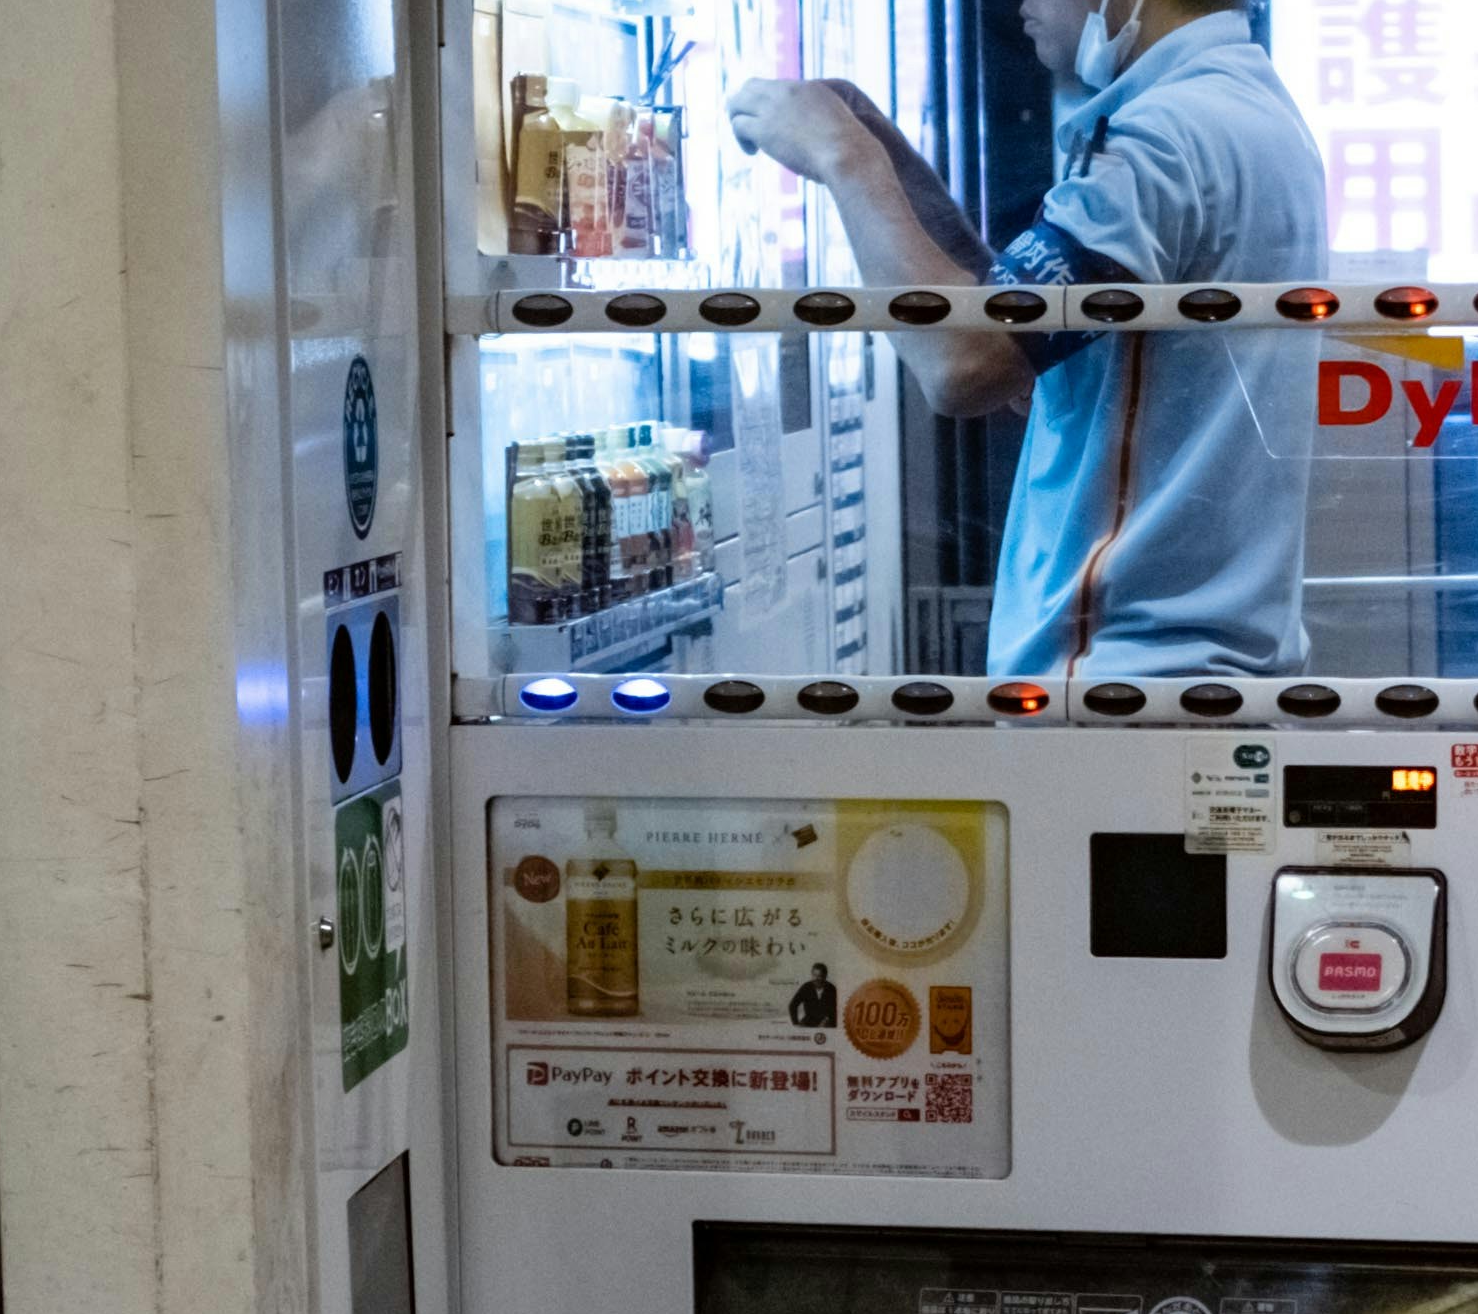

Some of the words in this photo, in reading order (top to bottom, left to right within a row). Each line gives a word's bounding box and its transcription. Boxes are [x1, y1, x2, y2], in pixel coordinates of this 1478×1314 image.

[645, 832, 701, 844] PIERRE
[523, 870, 552, 885] New
[668, 907, 802, 927] さらに広がる
[665, 936, 806, 957] ミルクの味わい
[1324, 966, 1377, 978] PASMO
[854, 1001, 911, 1028] 100万
[551, 1066, 614, 1085] PayPay
[625, 1068, 818, 1092] ポイント交換に新登場!
[848, 1090, 916, 1103] ダウンロード
